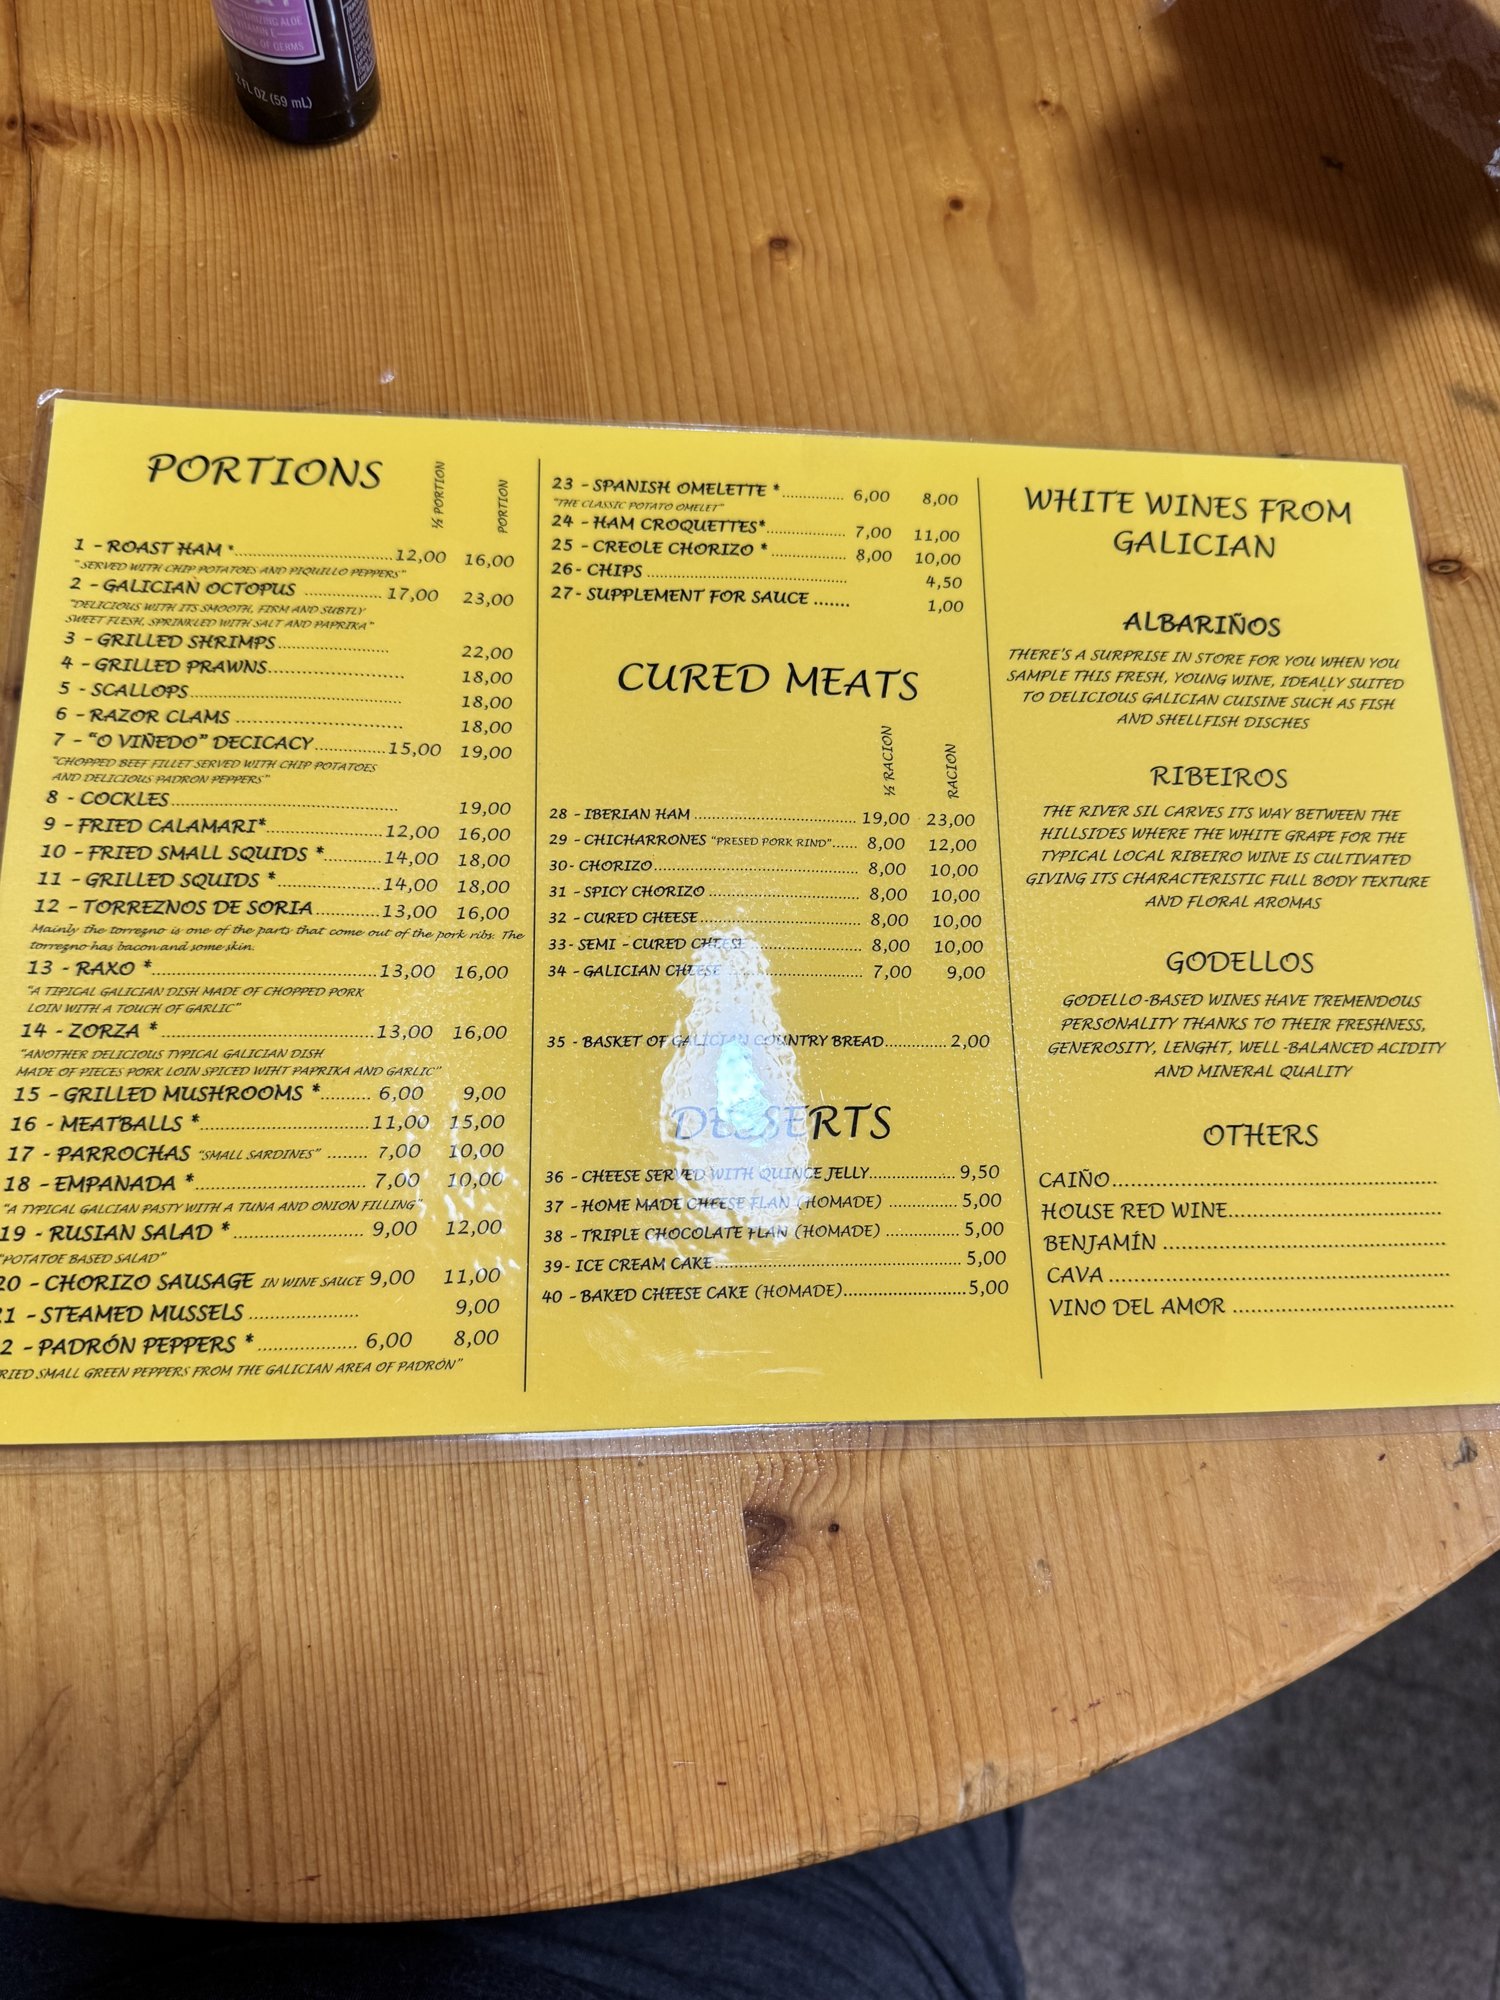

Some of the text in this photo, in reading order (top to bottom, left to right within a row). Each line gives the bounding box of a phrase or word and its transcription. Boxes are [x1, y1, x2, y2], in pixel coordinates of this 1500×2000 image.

[241, 78, 254, 95] FL
[253, 86, 268, 102] OZ
[269, 92, 288, 108] (59
[291, 95, 313, 110] mL)
[148, 453, 383, 489] PORTIONS
[433, 461, 445, 514] PORTION
[552, 477, 958, 506] 23 SPANISH OMELETTE 6,00 8,00
[497, 479, 508, 533] PORTION
[1024, 487, 1351, 524] WHITE WINES FROM
[74, 538, 514, 568] 1 ROAST HAM 12,00 16,00
[1114, 530, 1275, 558] GALICIAN
[551, 562, 962, 590] 26 CHIPS 4,50
[551, 586, 963, 614] 27 SUPPLEMENT FOR SAUCE 1,00
[1122, 611, 1281, 637] ALBARIÑOS
[64, 632, 513, 661] 3 GRILLED SHRIMPS 22,00
[1009, 648, 1400, 669] THERE'S A SURPRISE IN STORE FOR YOU WHEN YOU
[618, 662, 918, 701] CURED MEATS
[58, 681, 512, 710] 5 SCALLOPS 18,00
[54, 732, 65, 746] 7
[213, 735, 314, 750] DECICACY
[389, 742, 441, 757] 15,00
[461, 745, 512, 760] 19,00
[882, 726, 894, 781] RACION
[119, 759, 150, 768] BEEF
[151, 760, 194, 768] FILLET
[194, 760, 241, 768] SERVED
[244, 760, 277, 769] WITH
[279, 760, 312, 769] CHIP
[314, 761, 377, 772] POTATOES
[945, 744, 959, 799] RACION
[1150, 766, 1287, 788] RIBEIROS
[46, 790, 511, 817] 8 COCKLES 19,00
[549, 808, 975, 828] 28 IBERIAN HAM 19,00 23,00
[549, 834, 567, 845] 29
[584, 834, 707, 846] CHICHARRONES
[762, 838, 792, 846] PORK
[867, 837, 905, 851] 8,00
[929, 839, 976, 853] 12,00
[40, 844, 510, 869] 10 FRIED SMALL SQUIDS 14,00 18,00
[549, 860, 978, 878] 30 CHORIZO 8,00 10,00
[34, 899, 509, 922] 12 TORREZNOS DE SORIA 13,00 16,00
[1166, 950, 1314, 974] GODELLOS
[1063, 993, 1422, 1008] GODELLO-BASED WINES HAVE TREMENDOUS
[14, 1084, 506, 1104] 15 GRILLED MUSHROOMS 6,00 9,00
[1203, 1123, 1318, 1147] OTHERS
[7, 1146, 35, 1162] 17
[57, 1144, 191, 1162] PARROCHAS
[379, 1144, 421, 1160] 7,00
[449, 1143, 504, 1160] 10,00
[1039, 1169, 1109, 1188] CAIÑO
[1041, 1201, 1227, 1220] HOUSE RED WINE
[1043, 1231, 1155, 1255] BENJAMÍN
[543, 1251, 1006, 1273] 39 ICE CREAM CAKE 5,00
[45, 1268, 500, 1292] CHORIZO SAUSAGE IN WINE SAUCE 9,00 11,00
[1047, 1266, 1103, 1283] CAVA
[542, 1280, 1009, 1303] 40 BAKED CHEESE CAKE (HOMADE) 5,00
[1049, 1297, 1225, 1316] VINO DEL AMOR
[38, 1329, 499, 1356] PADRÓN PEPPERS 6,00 8,00
